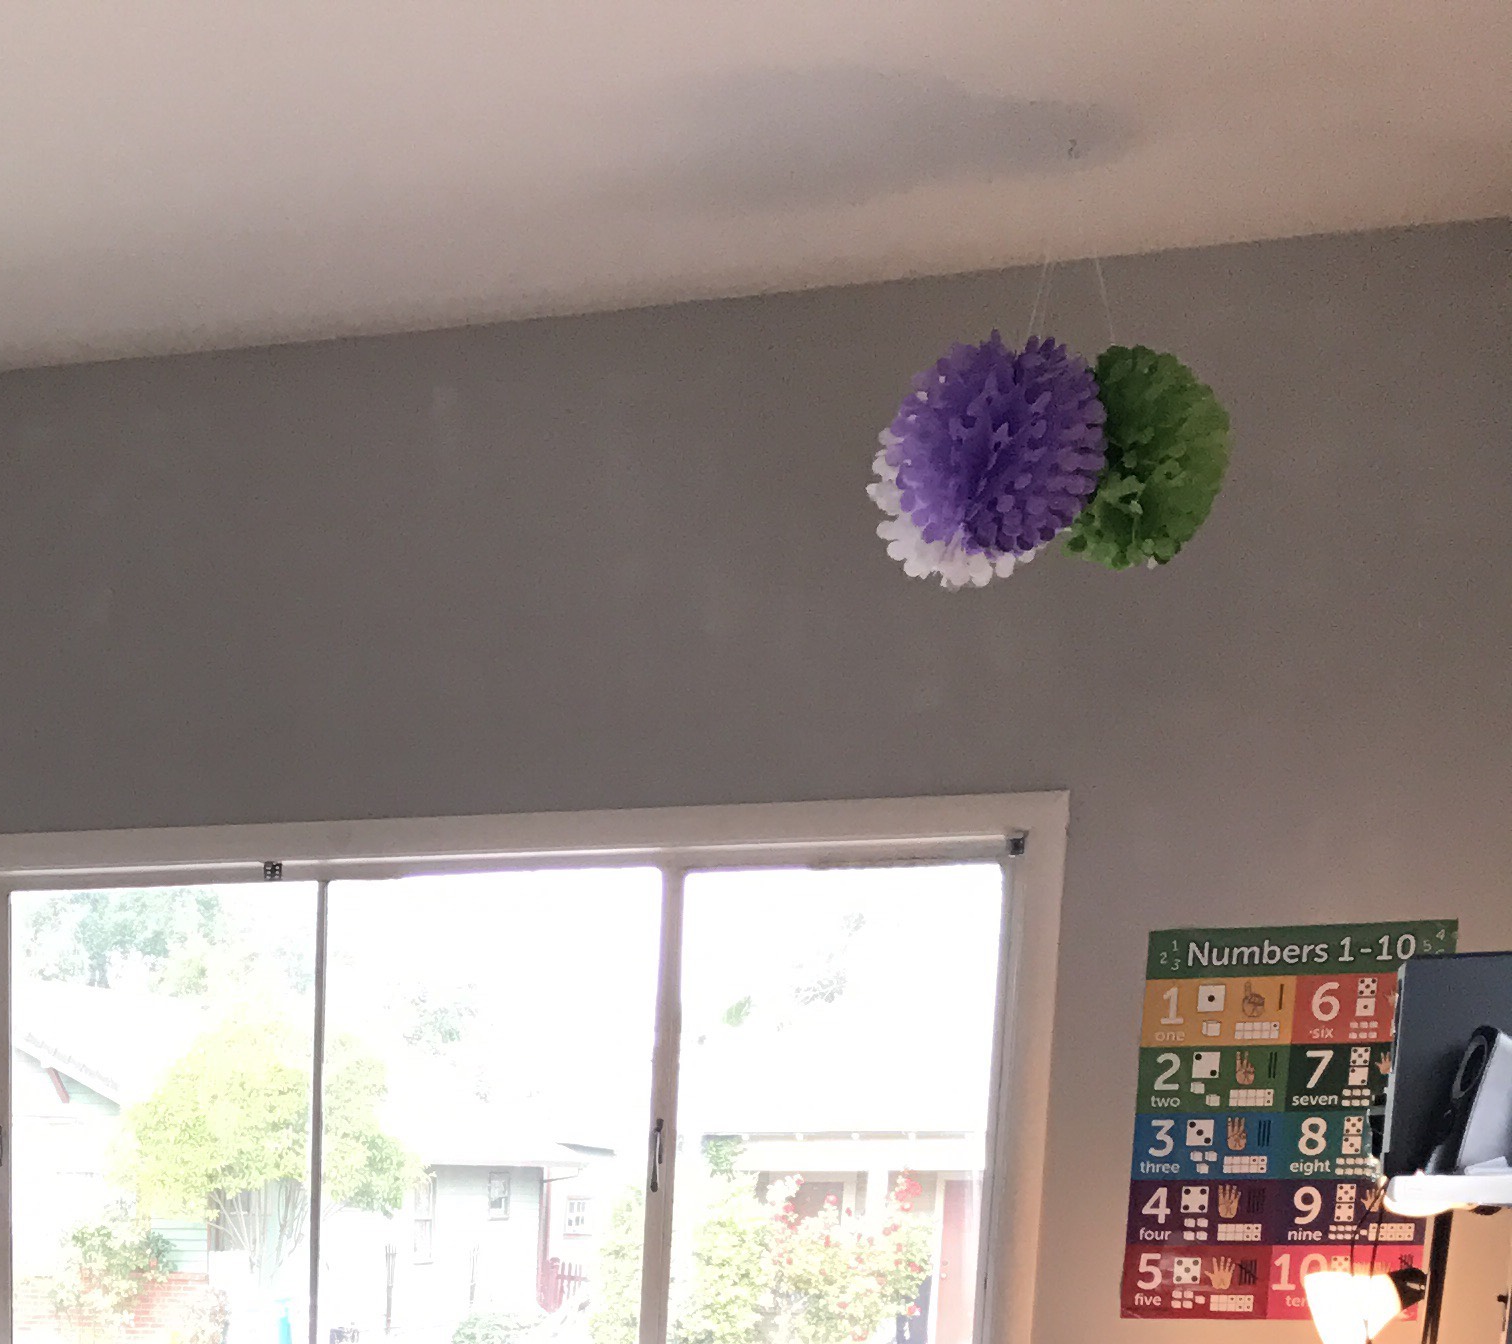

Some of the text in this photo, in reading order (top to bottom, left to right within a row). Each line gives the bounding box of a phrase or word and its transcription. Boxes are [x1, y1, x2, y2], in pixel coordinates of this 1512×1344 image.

[1188, 933, 1416, 968] Numbers 1-10
[1160, 982, 1341, 1026] 1 6
[1154, 1030, 1185, 1041] one
[1311, 1026, 1334, 1039] six
[1154, 1050, 1334, 1092] 2 7
[1151, 1094, 1338, 1107] two seven
[1148, 1116, 1327, 1157] 3 8
[1139, 1159, 1331, 1175] three eight
[1141, 1186, 1322, 1225] 4 9
[1139, 1226, 1322, 1241] four nine
[1137, 1253, 1162, 1289] 5
[1134, 1292, 1162, 1306] five
